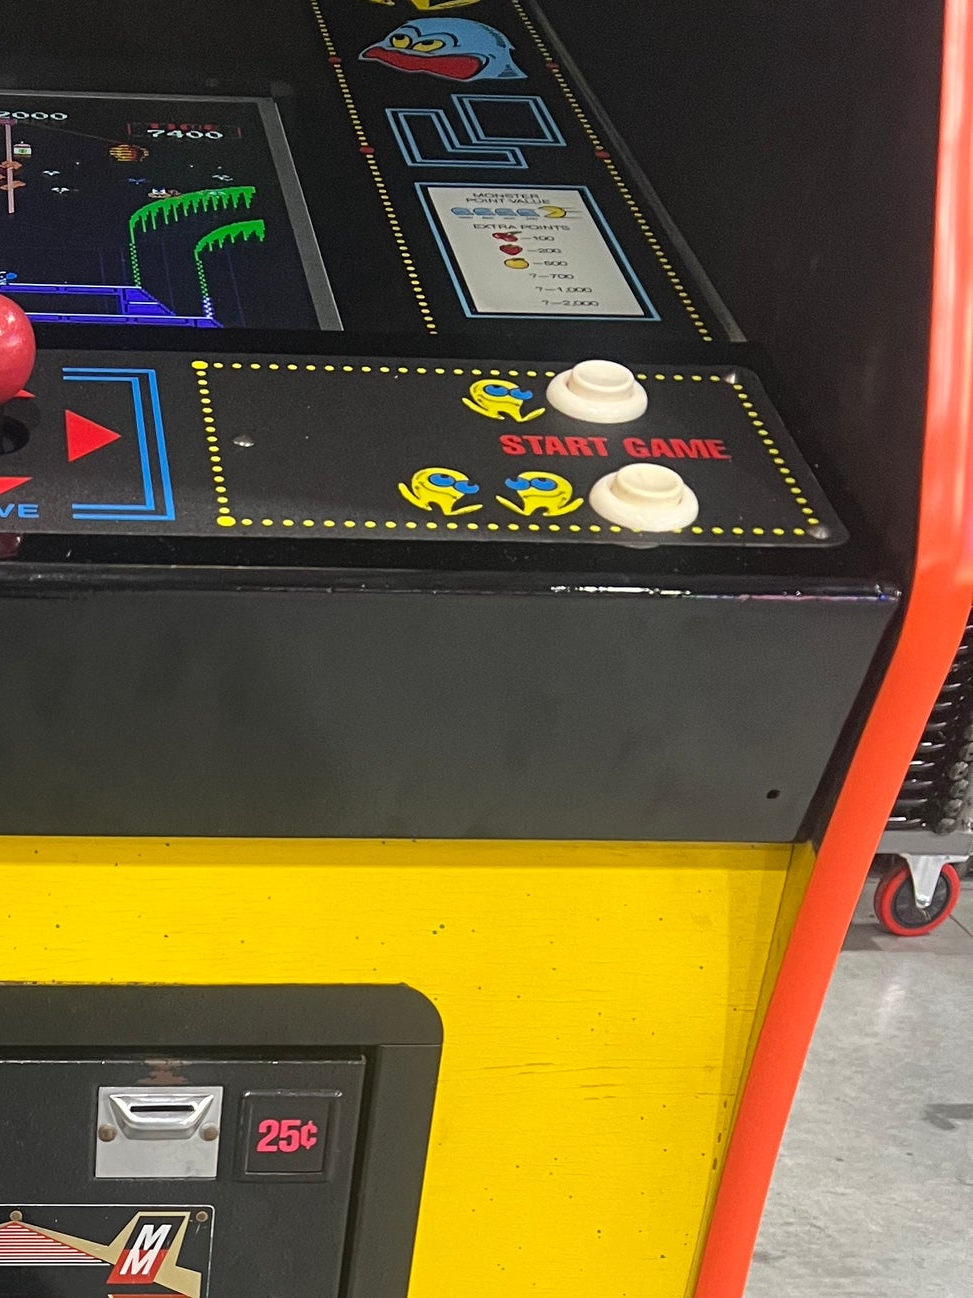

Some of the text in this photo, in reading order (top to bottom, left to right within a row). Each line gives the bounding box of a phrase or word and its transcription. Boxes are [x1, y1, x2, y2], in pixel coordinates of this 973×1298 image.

[146, 129, 224, 140] 7400
[498, 433, 732, 460] START GAME
[256, 1119, 319, 1153] 25¢
